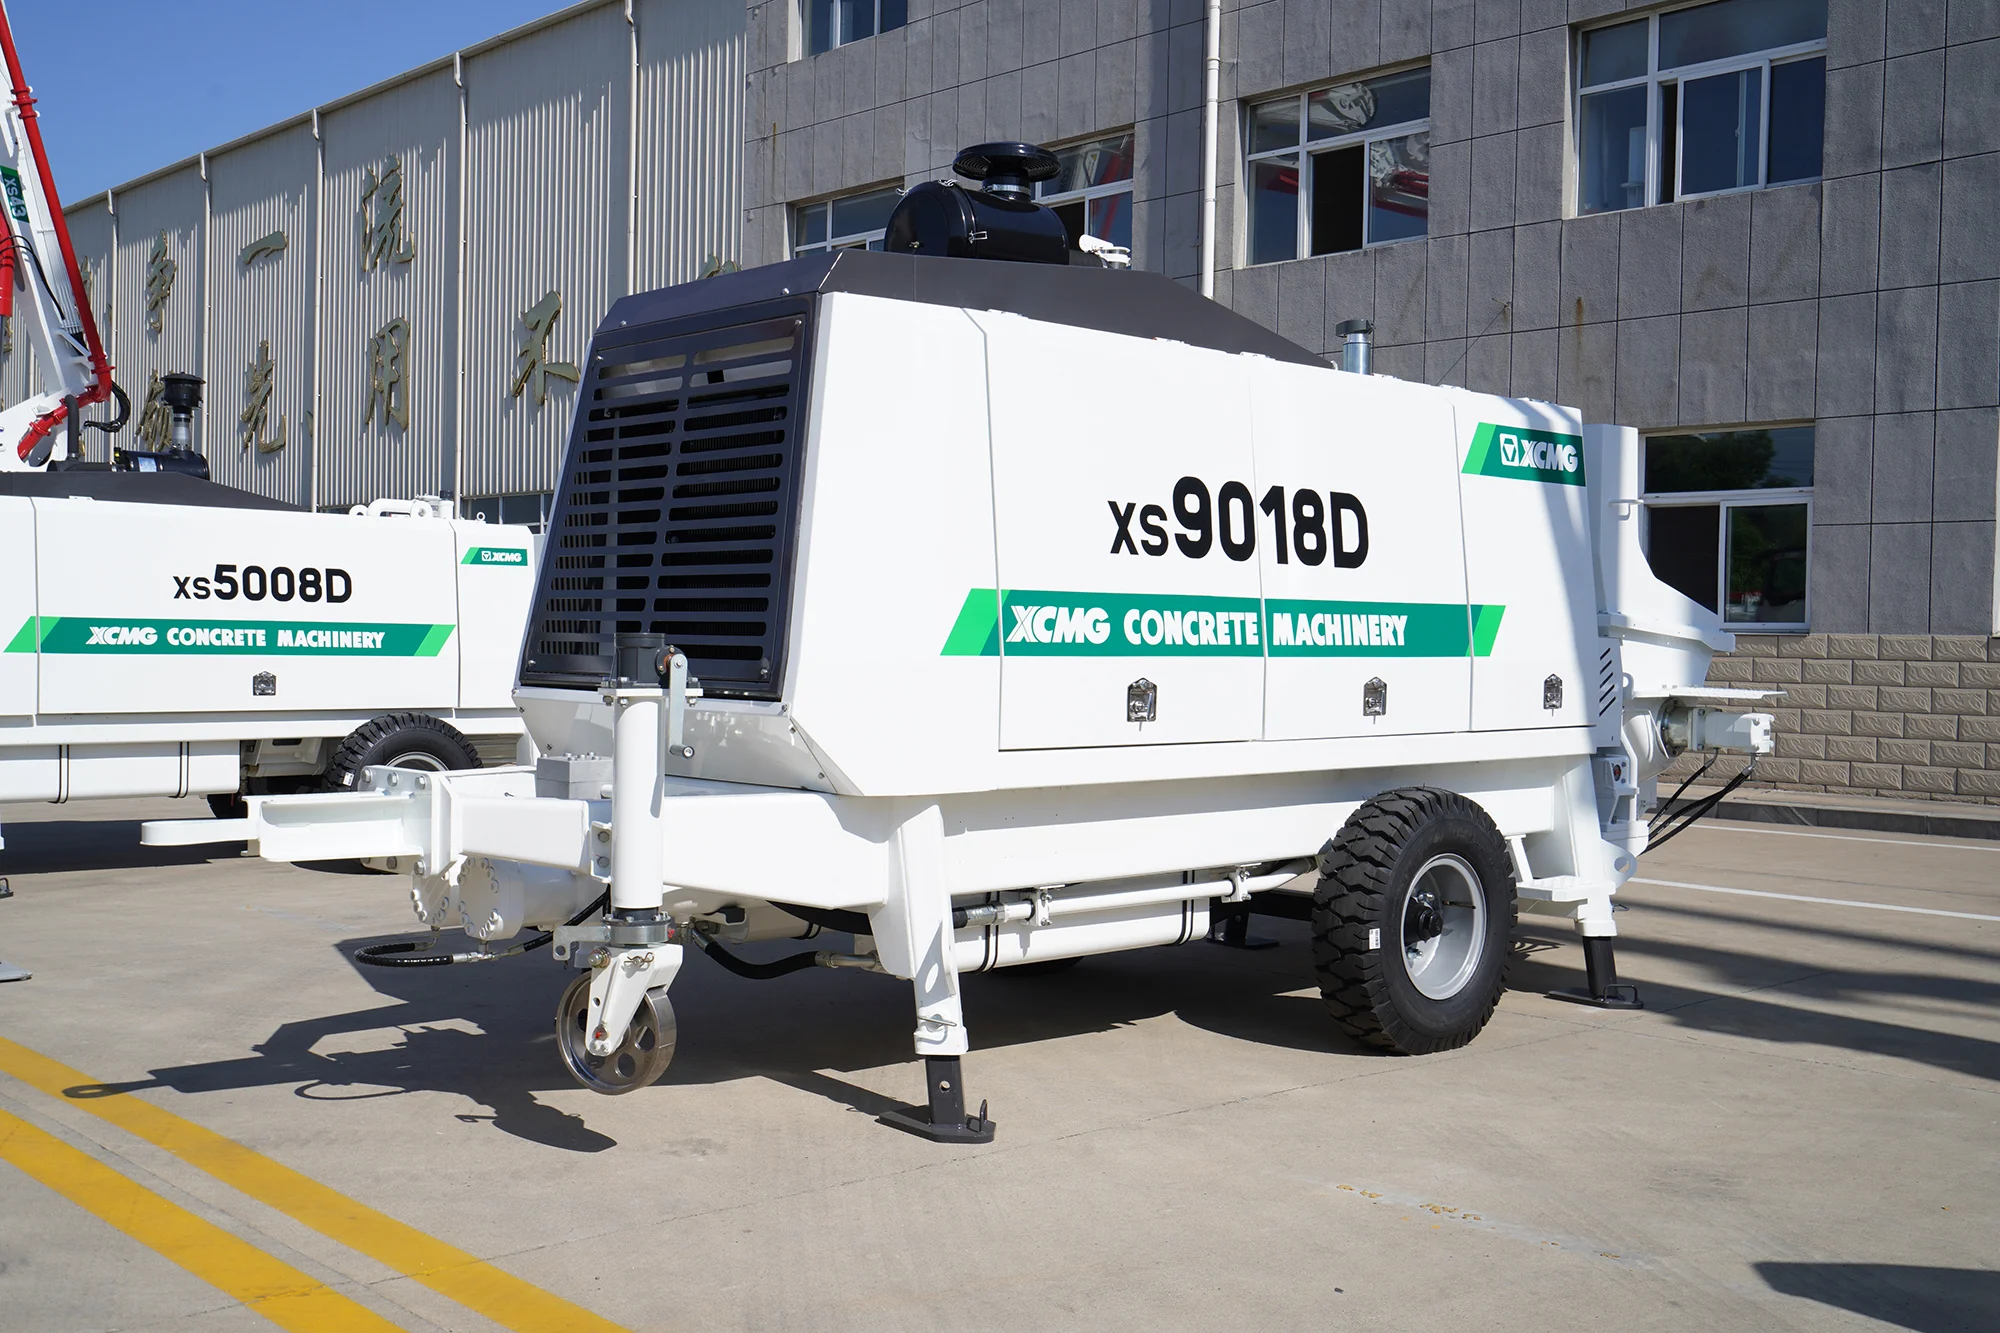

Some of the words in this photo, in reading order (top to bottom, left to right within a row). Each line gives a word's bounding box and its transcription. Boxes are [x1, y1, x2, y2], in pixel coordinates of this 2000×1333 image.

[4, 177, 27, 218] XS43
[1519, 439, 1579, 473] XCMG
[491, 551, 523, 563] XCMG
[85, 625, 158, 646] XCMG
[166, 627, 267, 648] CONCRETE
[277, 630, 386, 650] MACHINERY
[1006, 604, 1111, 645] XCMG
[1123, 608, 1259, 646] CONCRETE
[1272, 612, 1409, 648] MACHINERY
